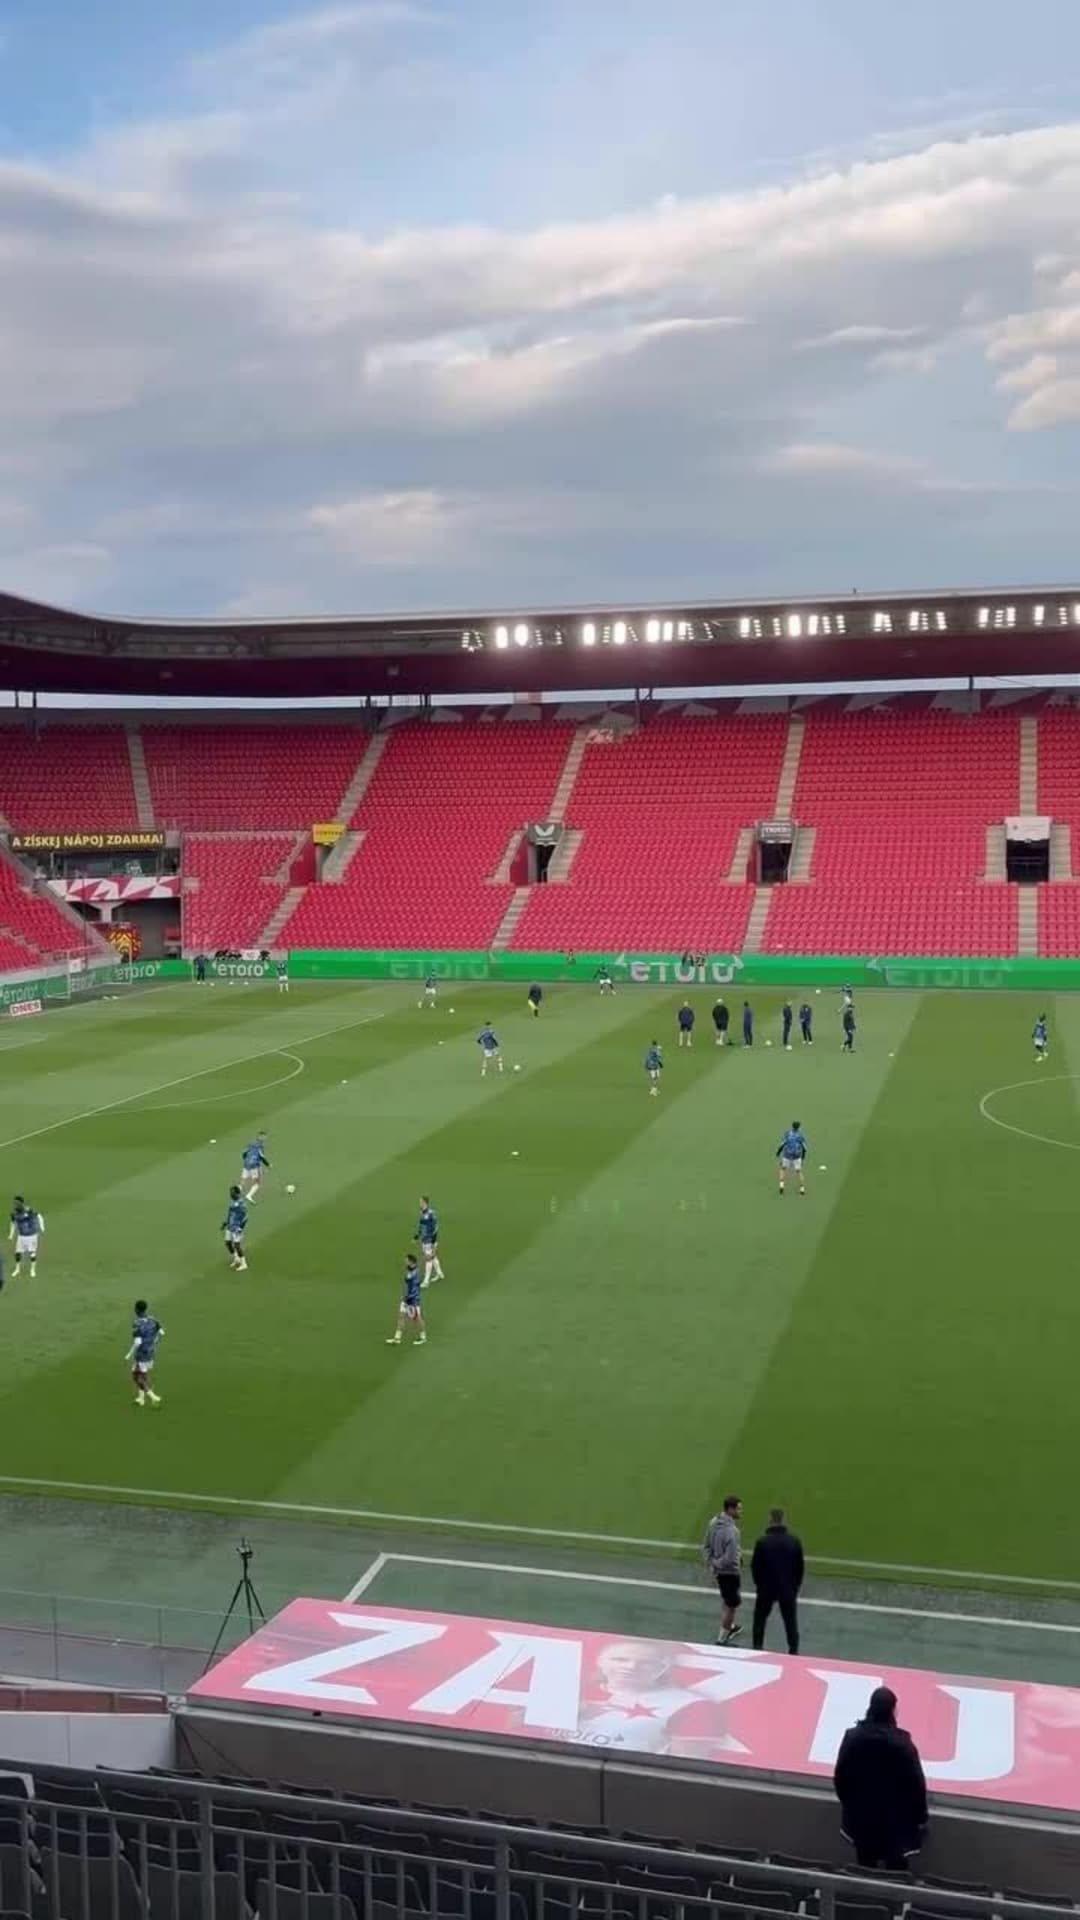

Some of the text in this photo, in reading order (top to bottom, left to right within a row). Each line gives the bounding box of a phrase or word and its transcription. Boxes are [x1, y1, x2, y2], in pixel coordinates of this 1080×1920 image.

[12, 833, 163, 848] A ZÍSKEJ NÁPOJ ZDARMA!
